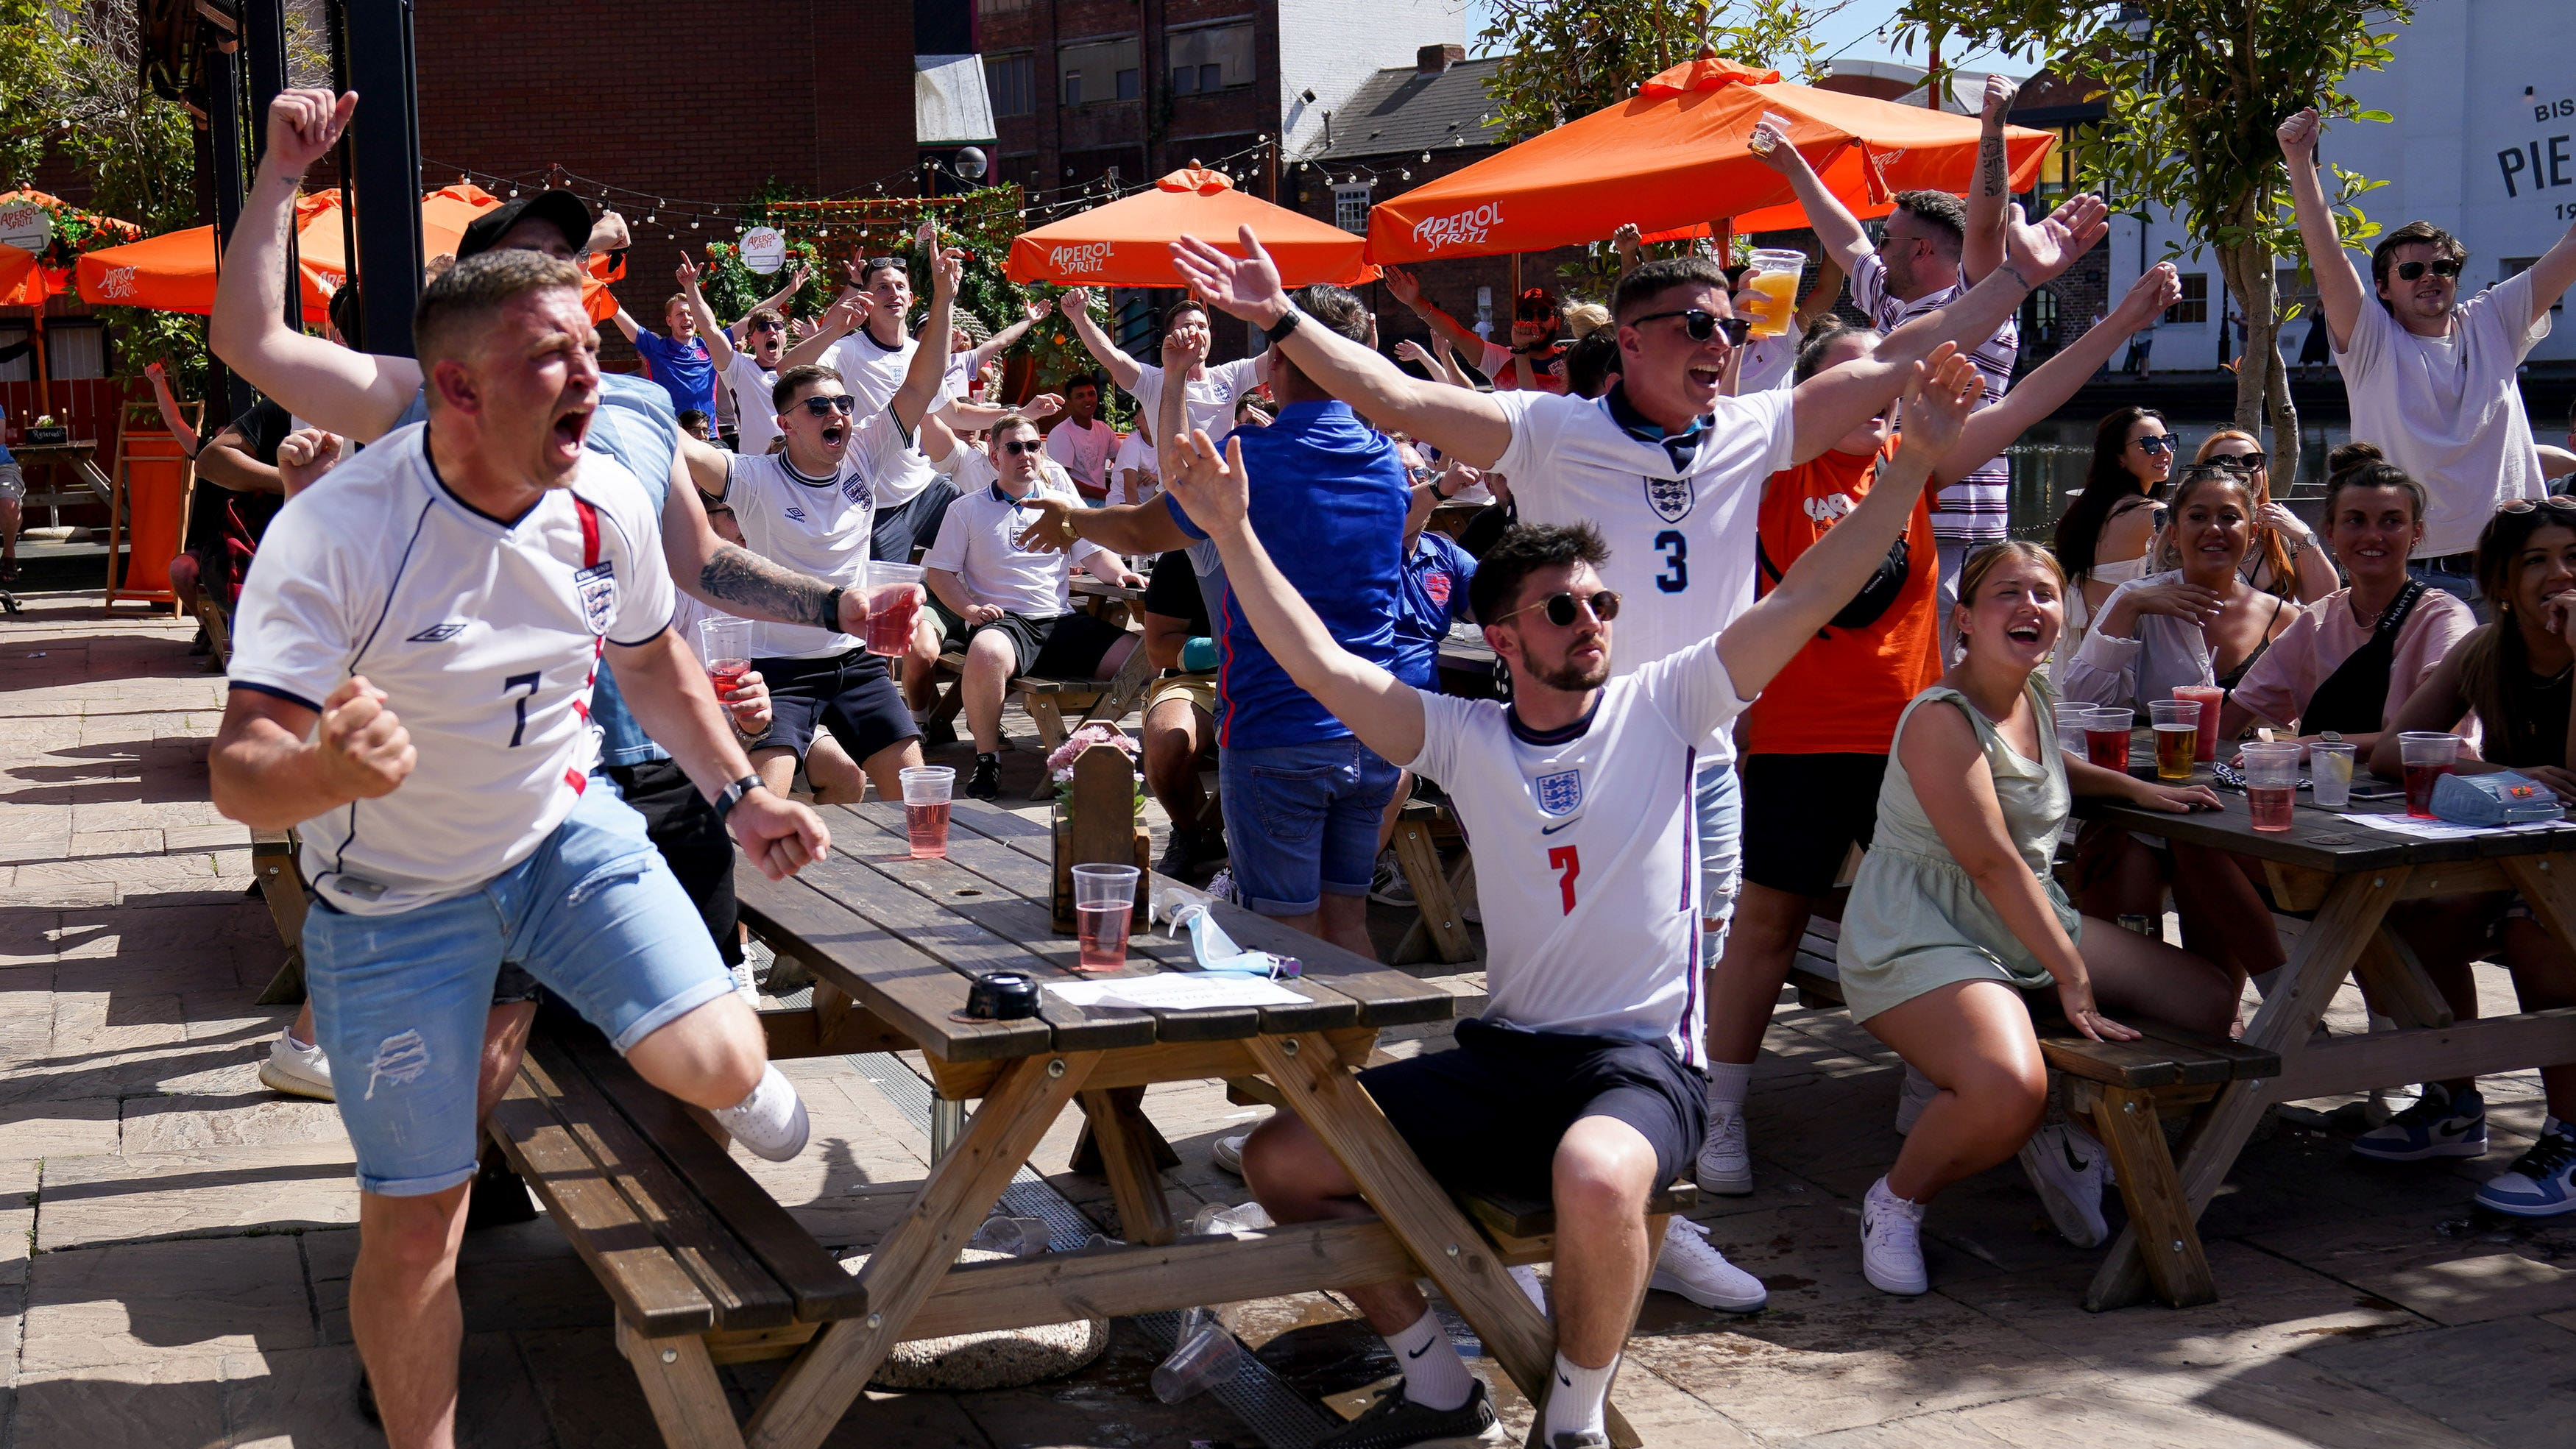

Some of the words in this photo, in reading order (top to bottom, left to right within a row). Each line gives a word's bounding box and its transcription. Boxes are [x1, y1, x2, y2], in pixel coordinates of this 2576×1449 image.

[2534, 99, 2575, 123] BIS
[2497, 135, 2572, 198] PIE
[0, 206, 39, 226] APEROL
[1413, 201, 1504, 243] APEROL
[747, 233, 777, 247] APEROL
[1049, 241, 1115, 266] APEROL
[1655, 529, 1688, 594] 3
[503, 670, 542, 748] 7
[1548, 845, 1580, 916] 7
